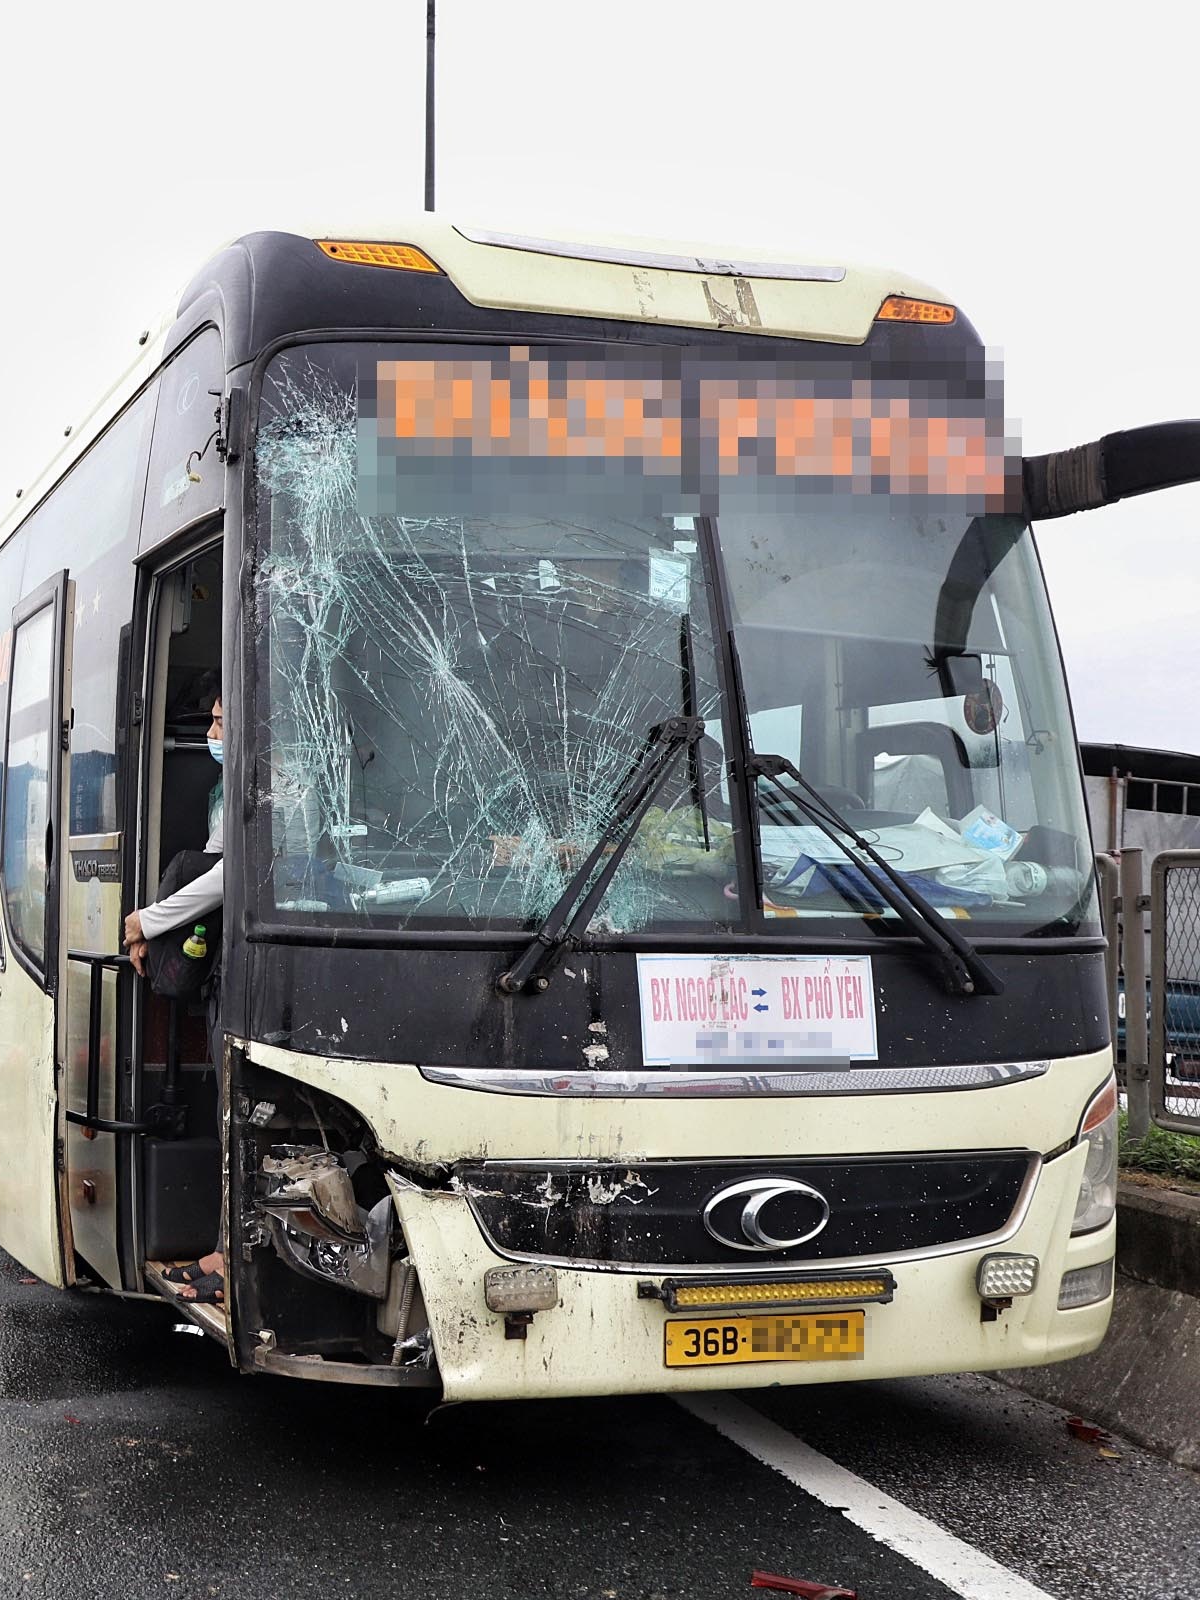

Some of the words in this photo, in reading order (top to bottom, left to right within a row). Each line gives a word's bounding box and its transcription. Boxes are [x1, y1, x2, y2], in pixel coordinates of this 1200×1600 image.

[74, 860, 97, 877] THACO
[650, 978, 672, 1021] BX
[781, 976, 802, 1020] BX
[805, 958, 833, 1020] PHỔ
[836, 966, 864, 1019] YÊN
